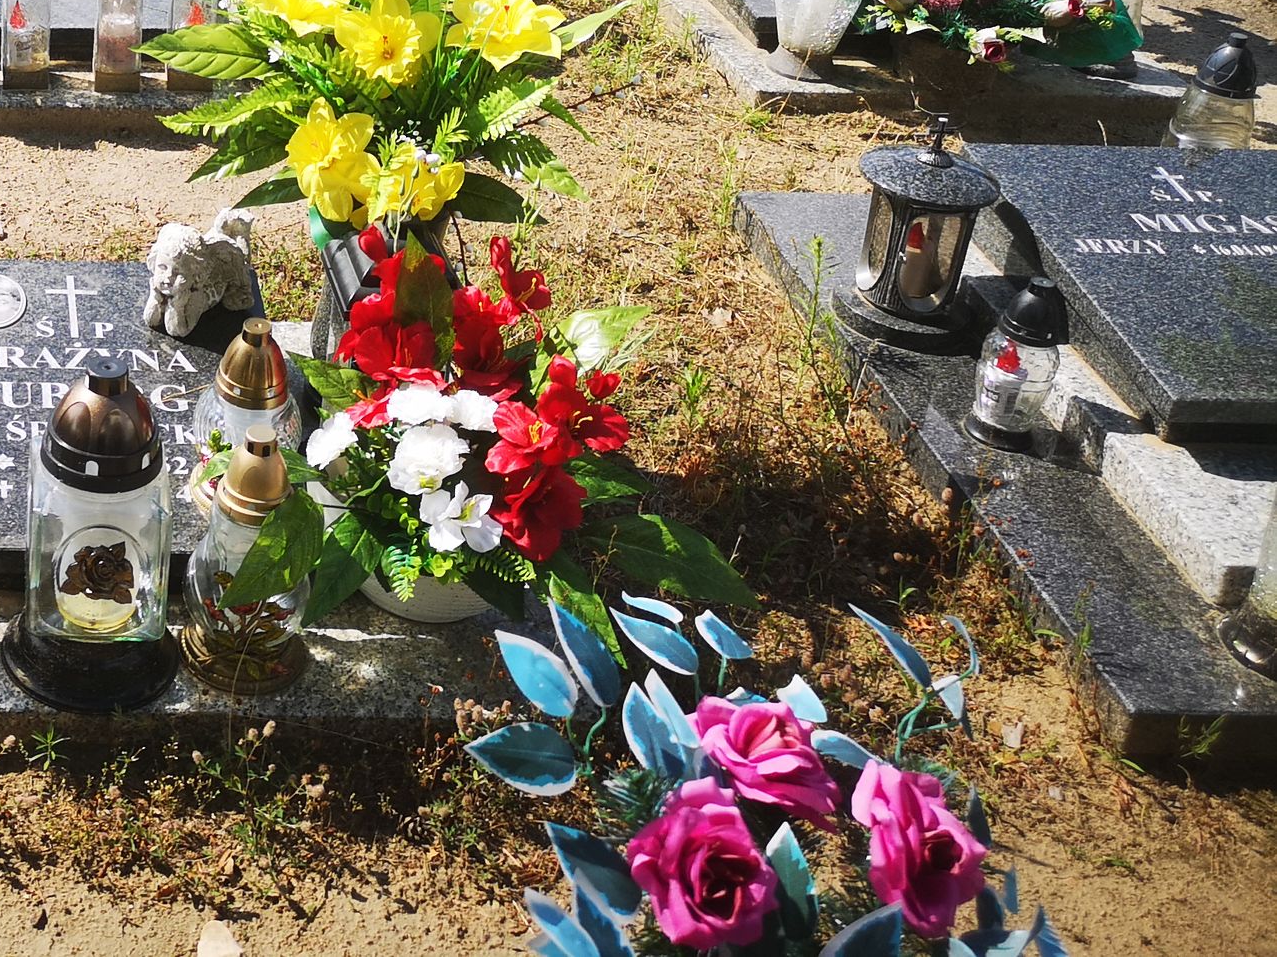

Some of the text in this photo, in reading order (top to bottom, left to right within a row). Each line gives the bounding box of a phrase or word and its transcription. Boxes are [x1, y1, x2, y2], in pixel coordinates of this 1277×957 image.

[1075, 238, 1167, 255] JERZY
[35, 318, 114, 338] Ś P
